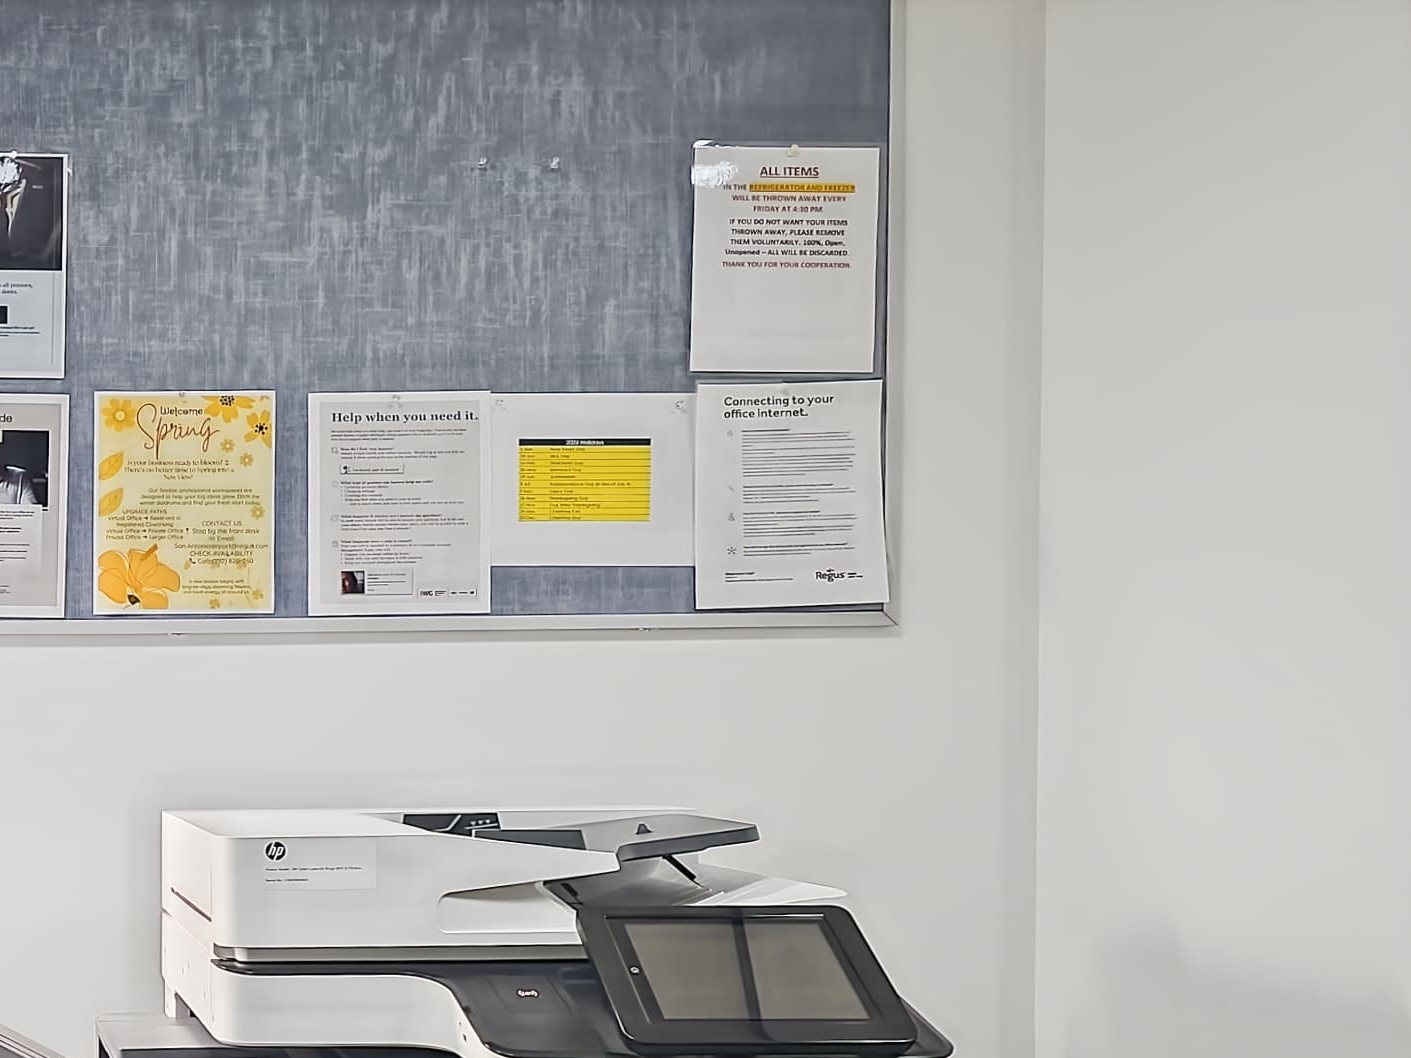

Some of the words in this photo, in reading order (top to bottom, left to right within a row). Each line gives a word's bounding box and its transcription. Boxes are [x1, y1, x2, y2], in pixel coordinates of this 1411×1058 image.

[760, 166, 781, 176] ALL
[783, 166, 820, 176] ITEMS
[724, 396, 789, 407] Connecting
[792, 396, 805, 405] to
[807, 396, 834, 407] your
[160, 406, 203, 416] Welcome
[724, 409, 755, 418] office
[757, 408, 808, 418] internet.
[332, 412, 362, 424] Help
[366, 412, 400, 422] when
[403, 413, 426, 424] you
[430, 411, 462, 421] need
[465, 410, 478, 421] it.
[137, 403, 220, 460] Spring
[816, 570, 845, 582] Regus
[267, 841, 285, 861] hp
